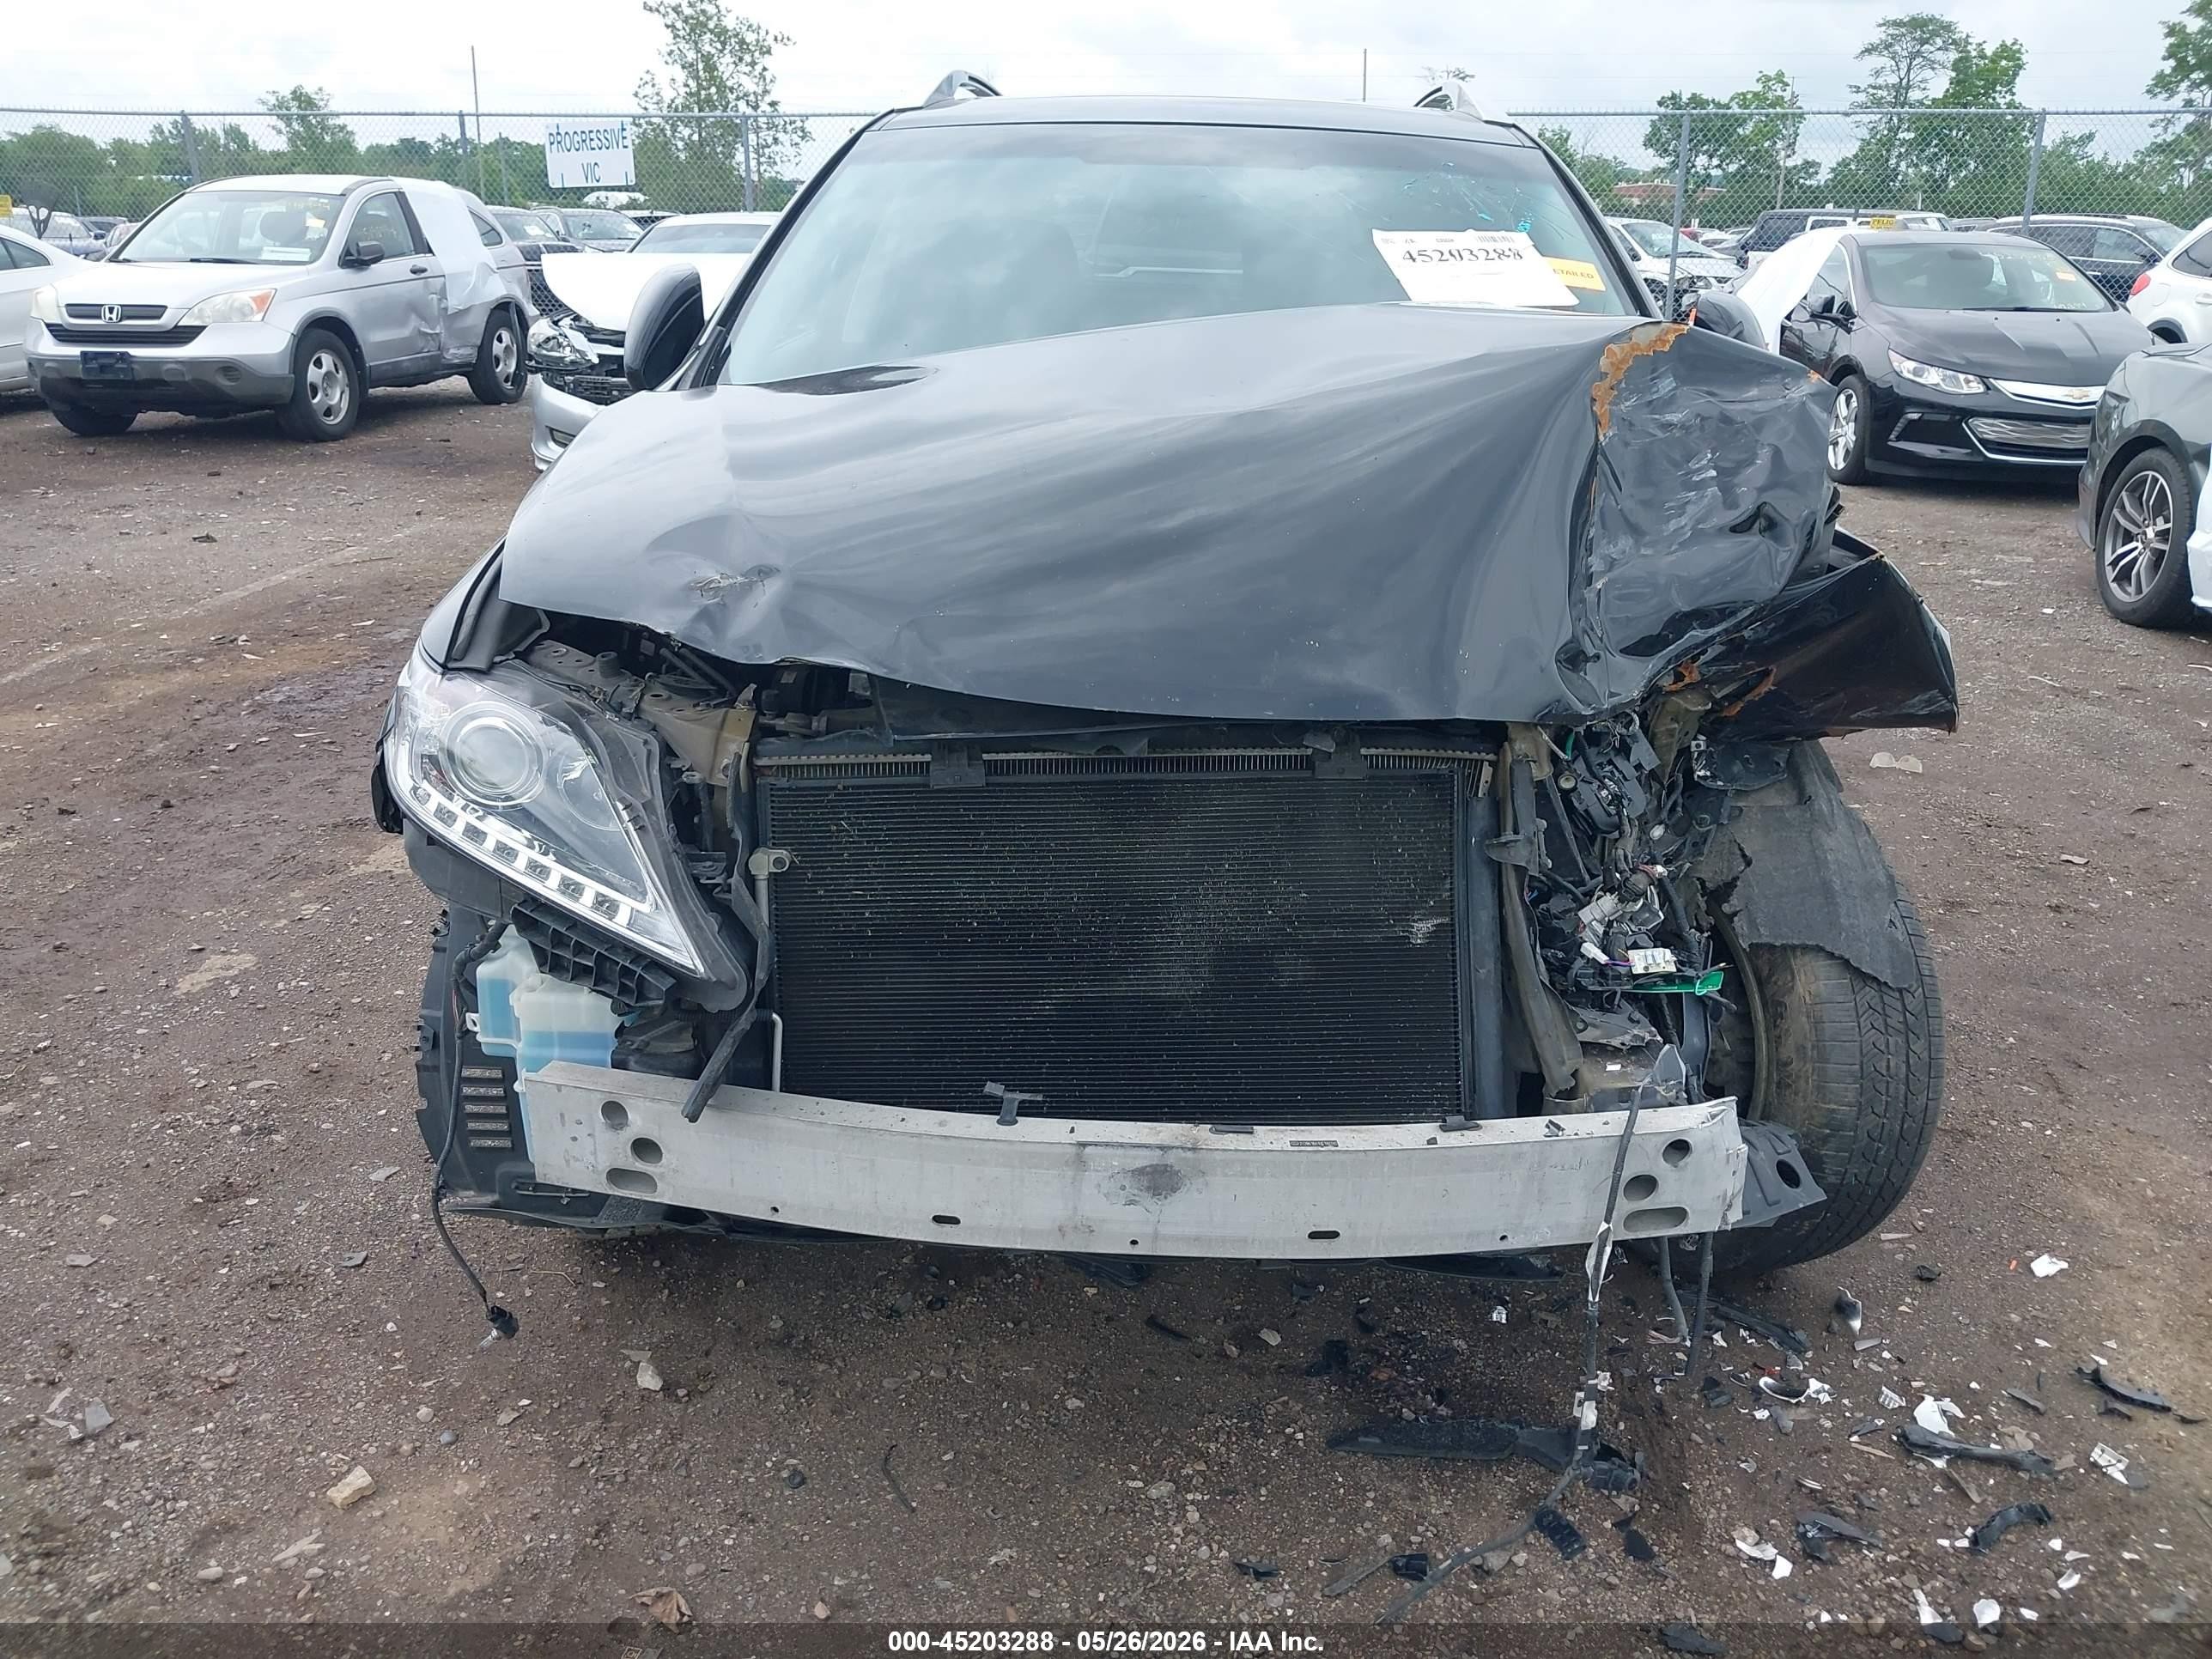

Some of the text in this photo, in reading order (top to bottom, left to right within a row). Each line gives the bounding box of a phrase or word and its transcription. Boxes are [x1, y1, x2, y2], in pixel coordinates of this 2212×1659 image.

[549, 128, 629, 153] PROGRESSIVE
[581, 161, 601, 184] VIC
[1402, 247, 1523, 263] 45203288
